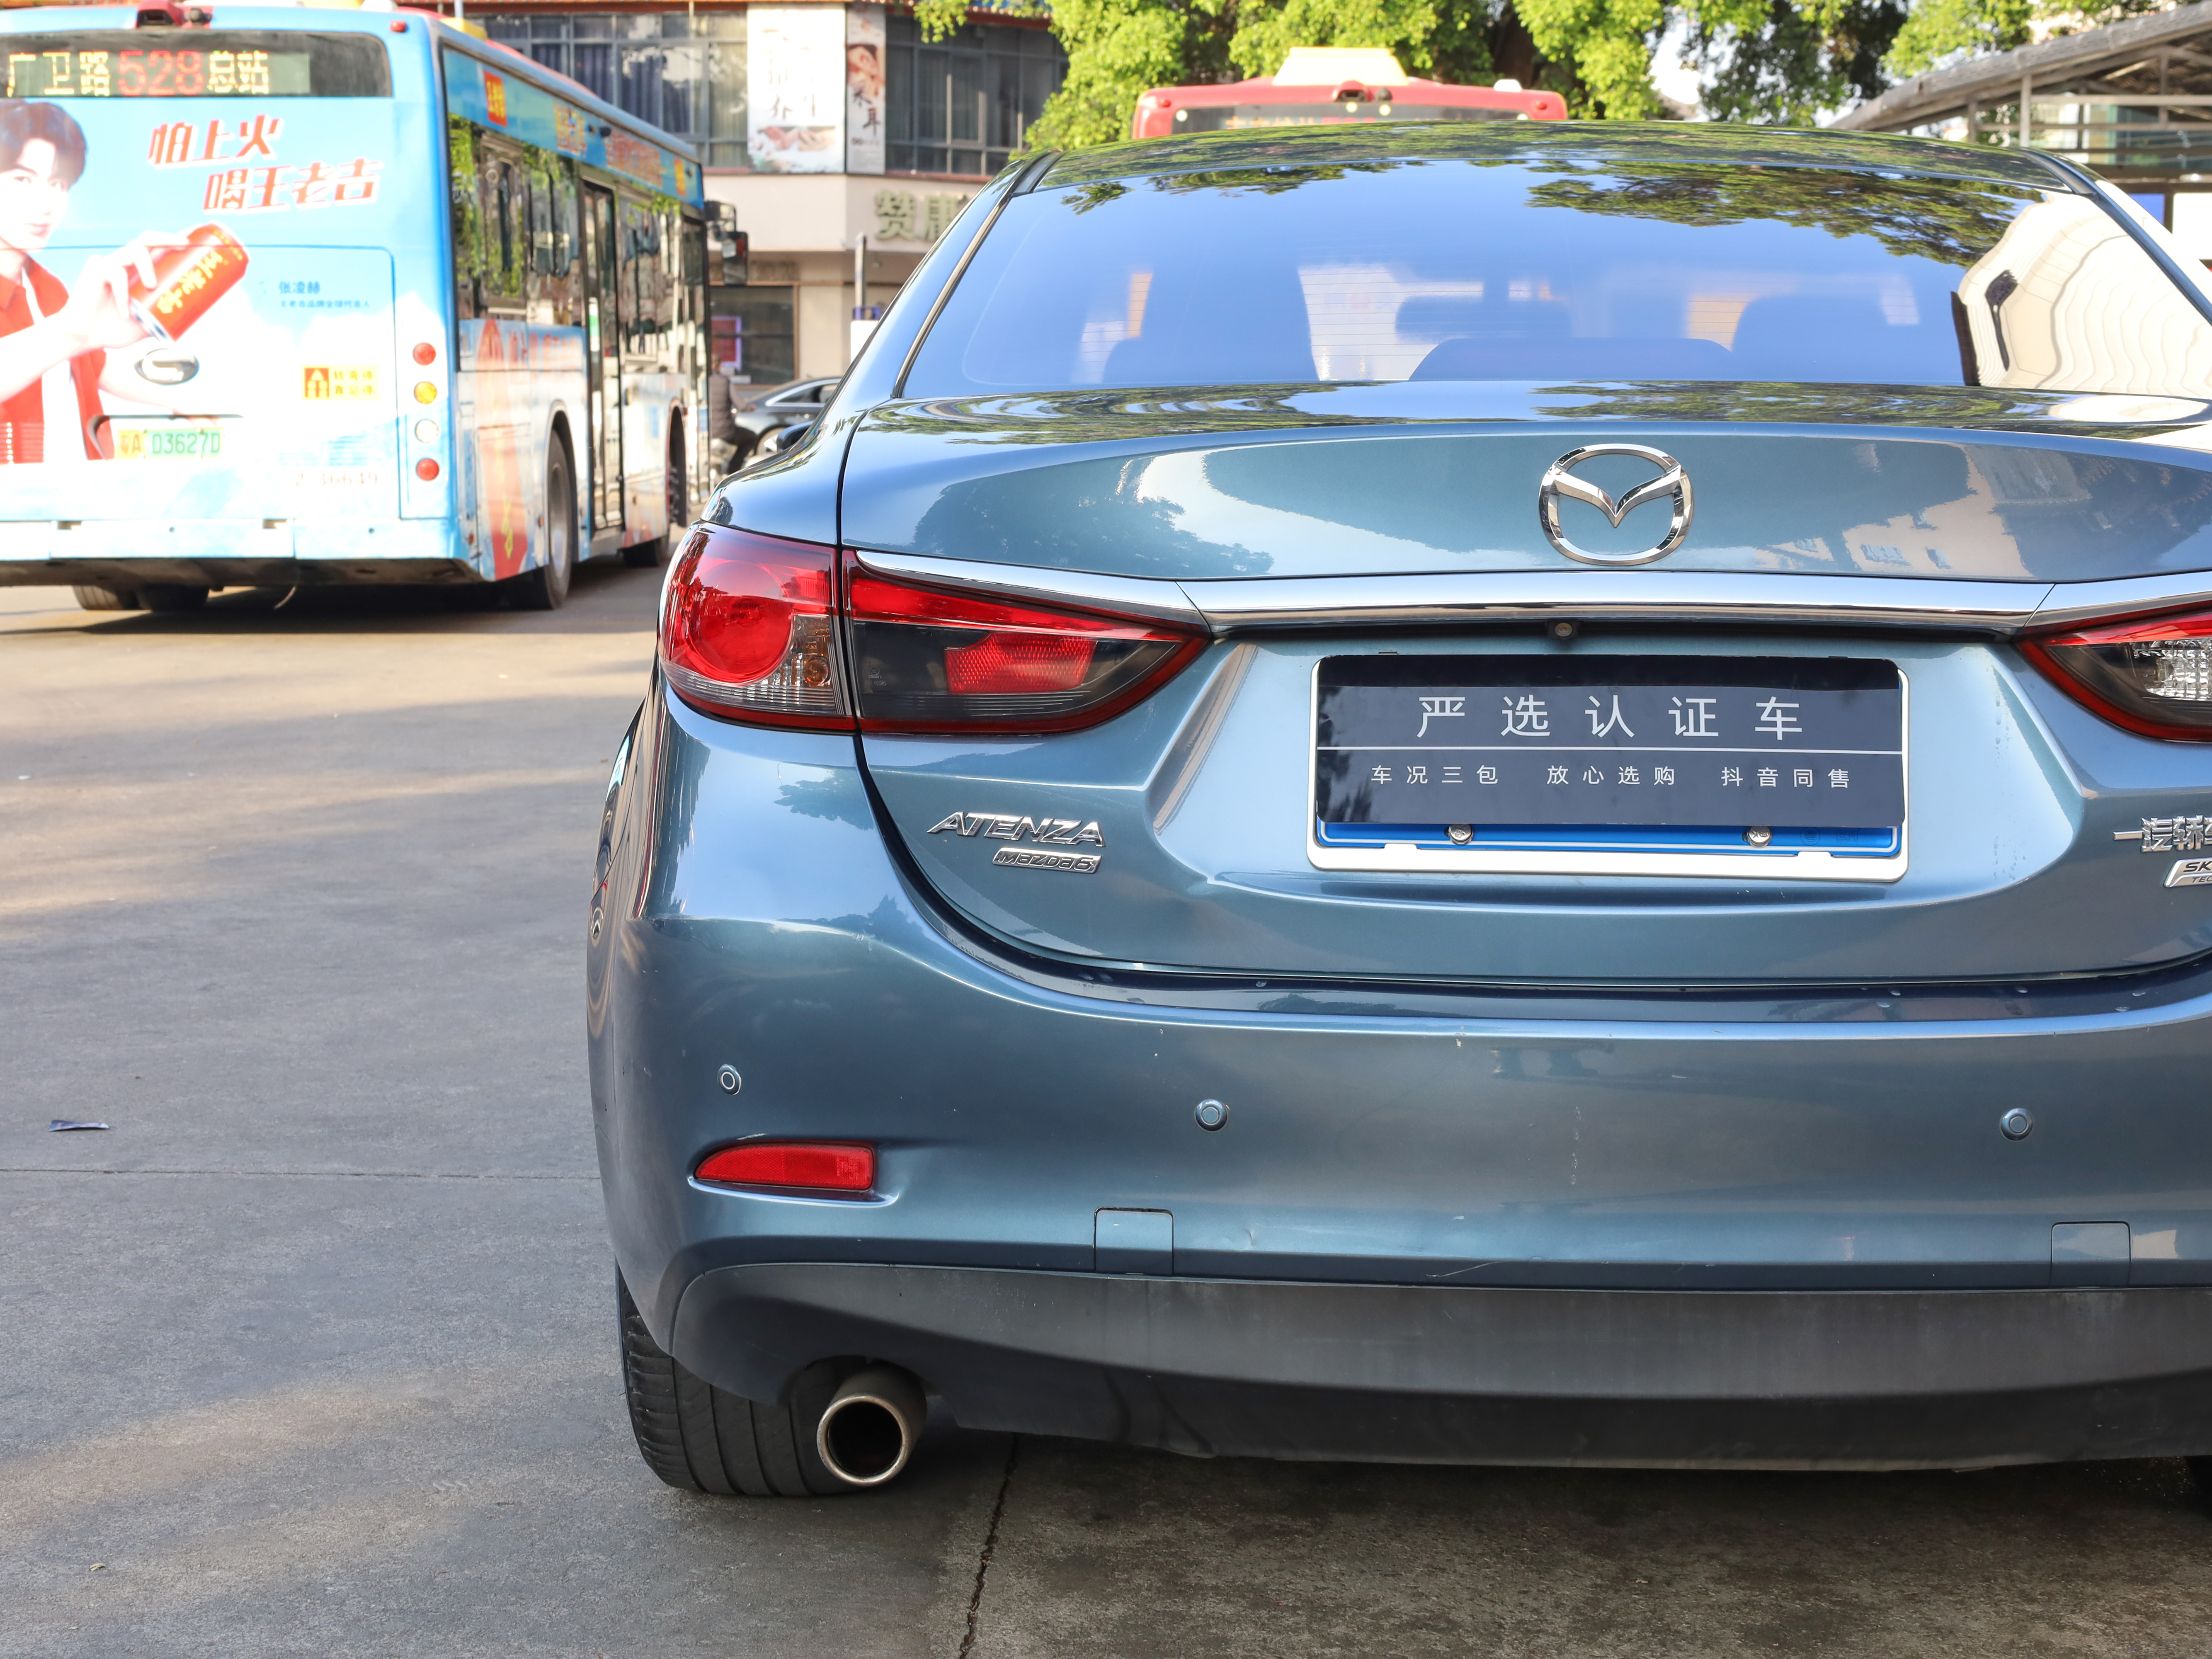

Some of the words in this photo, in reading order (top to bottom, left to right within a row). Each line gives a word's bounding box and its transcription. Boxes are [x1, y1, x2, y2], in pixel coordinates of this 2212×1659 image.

[147, 114, 284, 167] 怕上火
[202, 158, 383, 215] 喝王老吉
[1416, 694, 1802, 740] 严选认证车
[1371, 764, 1499, 785] 车况三包
[1546, 765, 1675, 786] 放心选购
[1721, 766, 1850, 788] 抖音同售
[926, 811, 1106, 847] ATENZA
